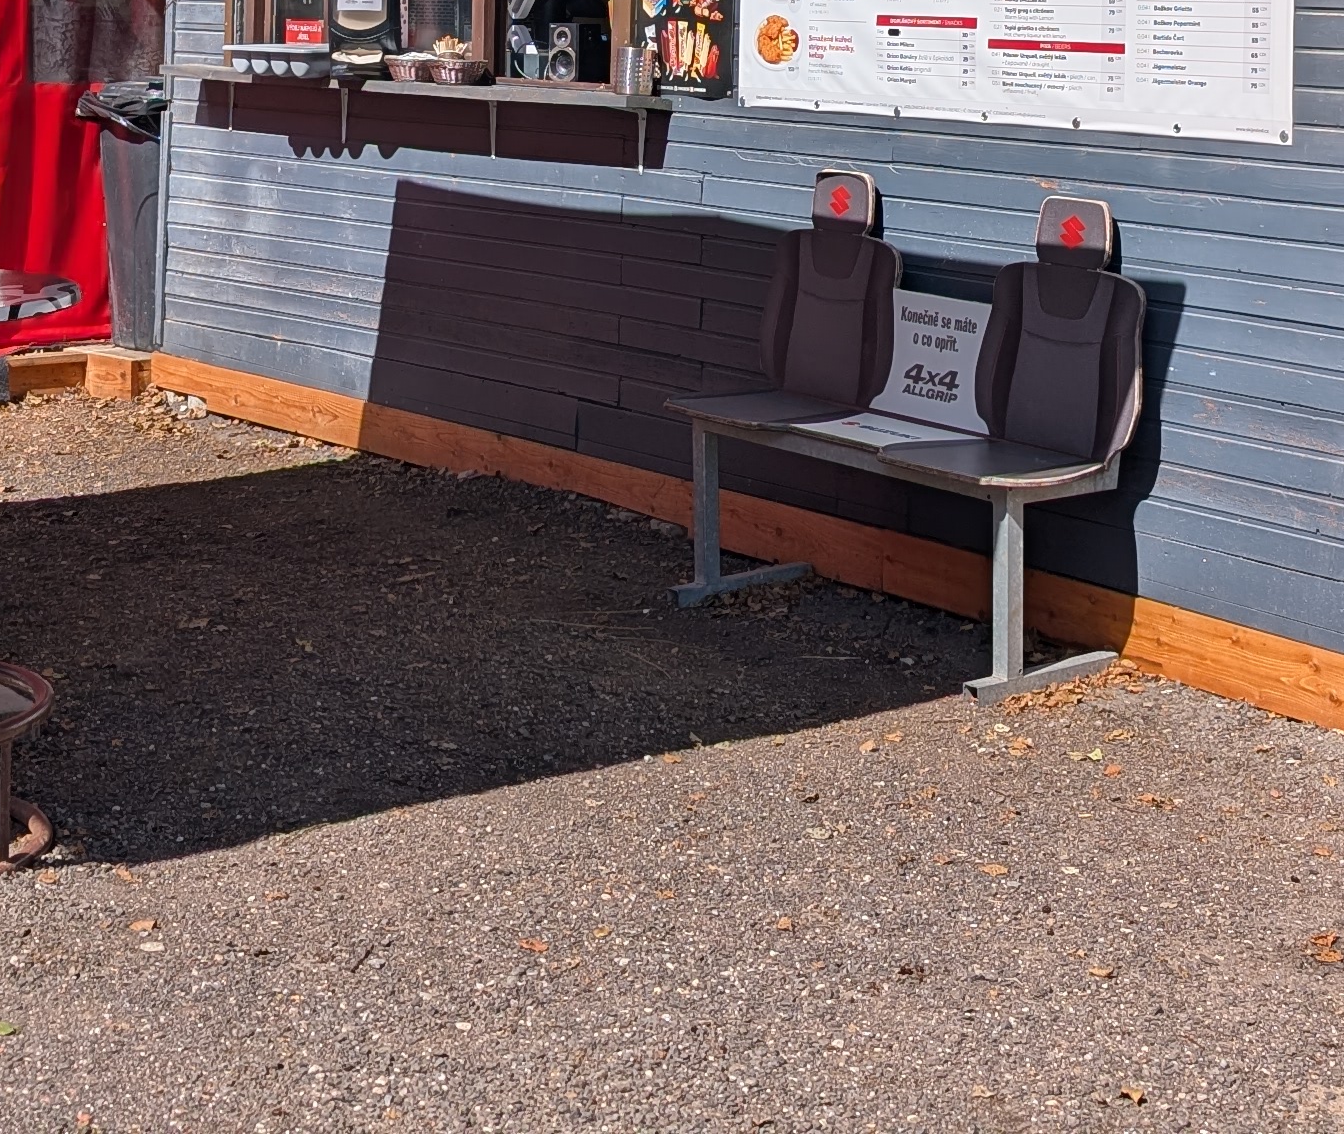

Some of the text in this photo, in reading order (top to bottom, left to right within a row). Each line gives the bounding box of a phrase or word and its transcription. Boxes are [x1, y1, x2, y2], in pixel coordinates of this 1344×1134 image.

[900, 305, 978, 334] Konečně se máte
[912, 332, 919, 345] o
[921, 334, 932, 348] co
[903, 363, 961, 392] 4x4
[901, 383, 959, 404] ALLGRIP
